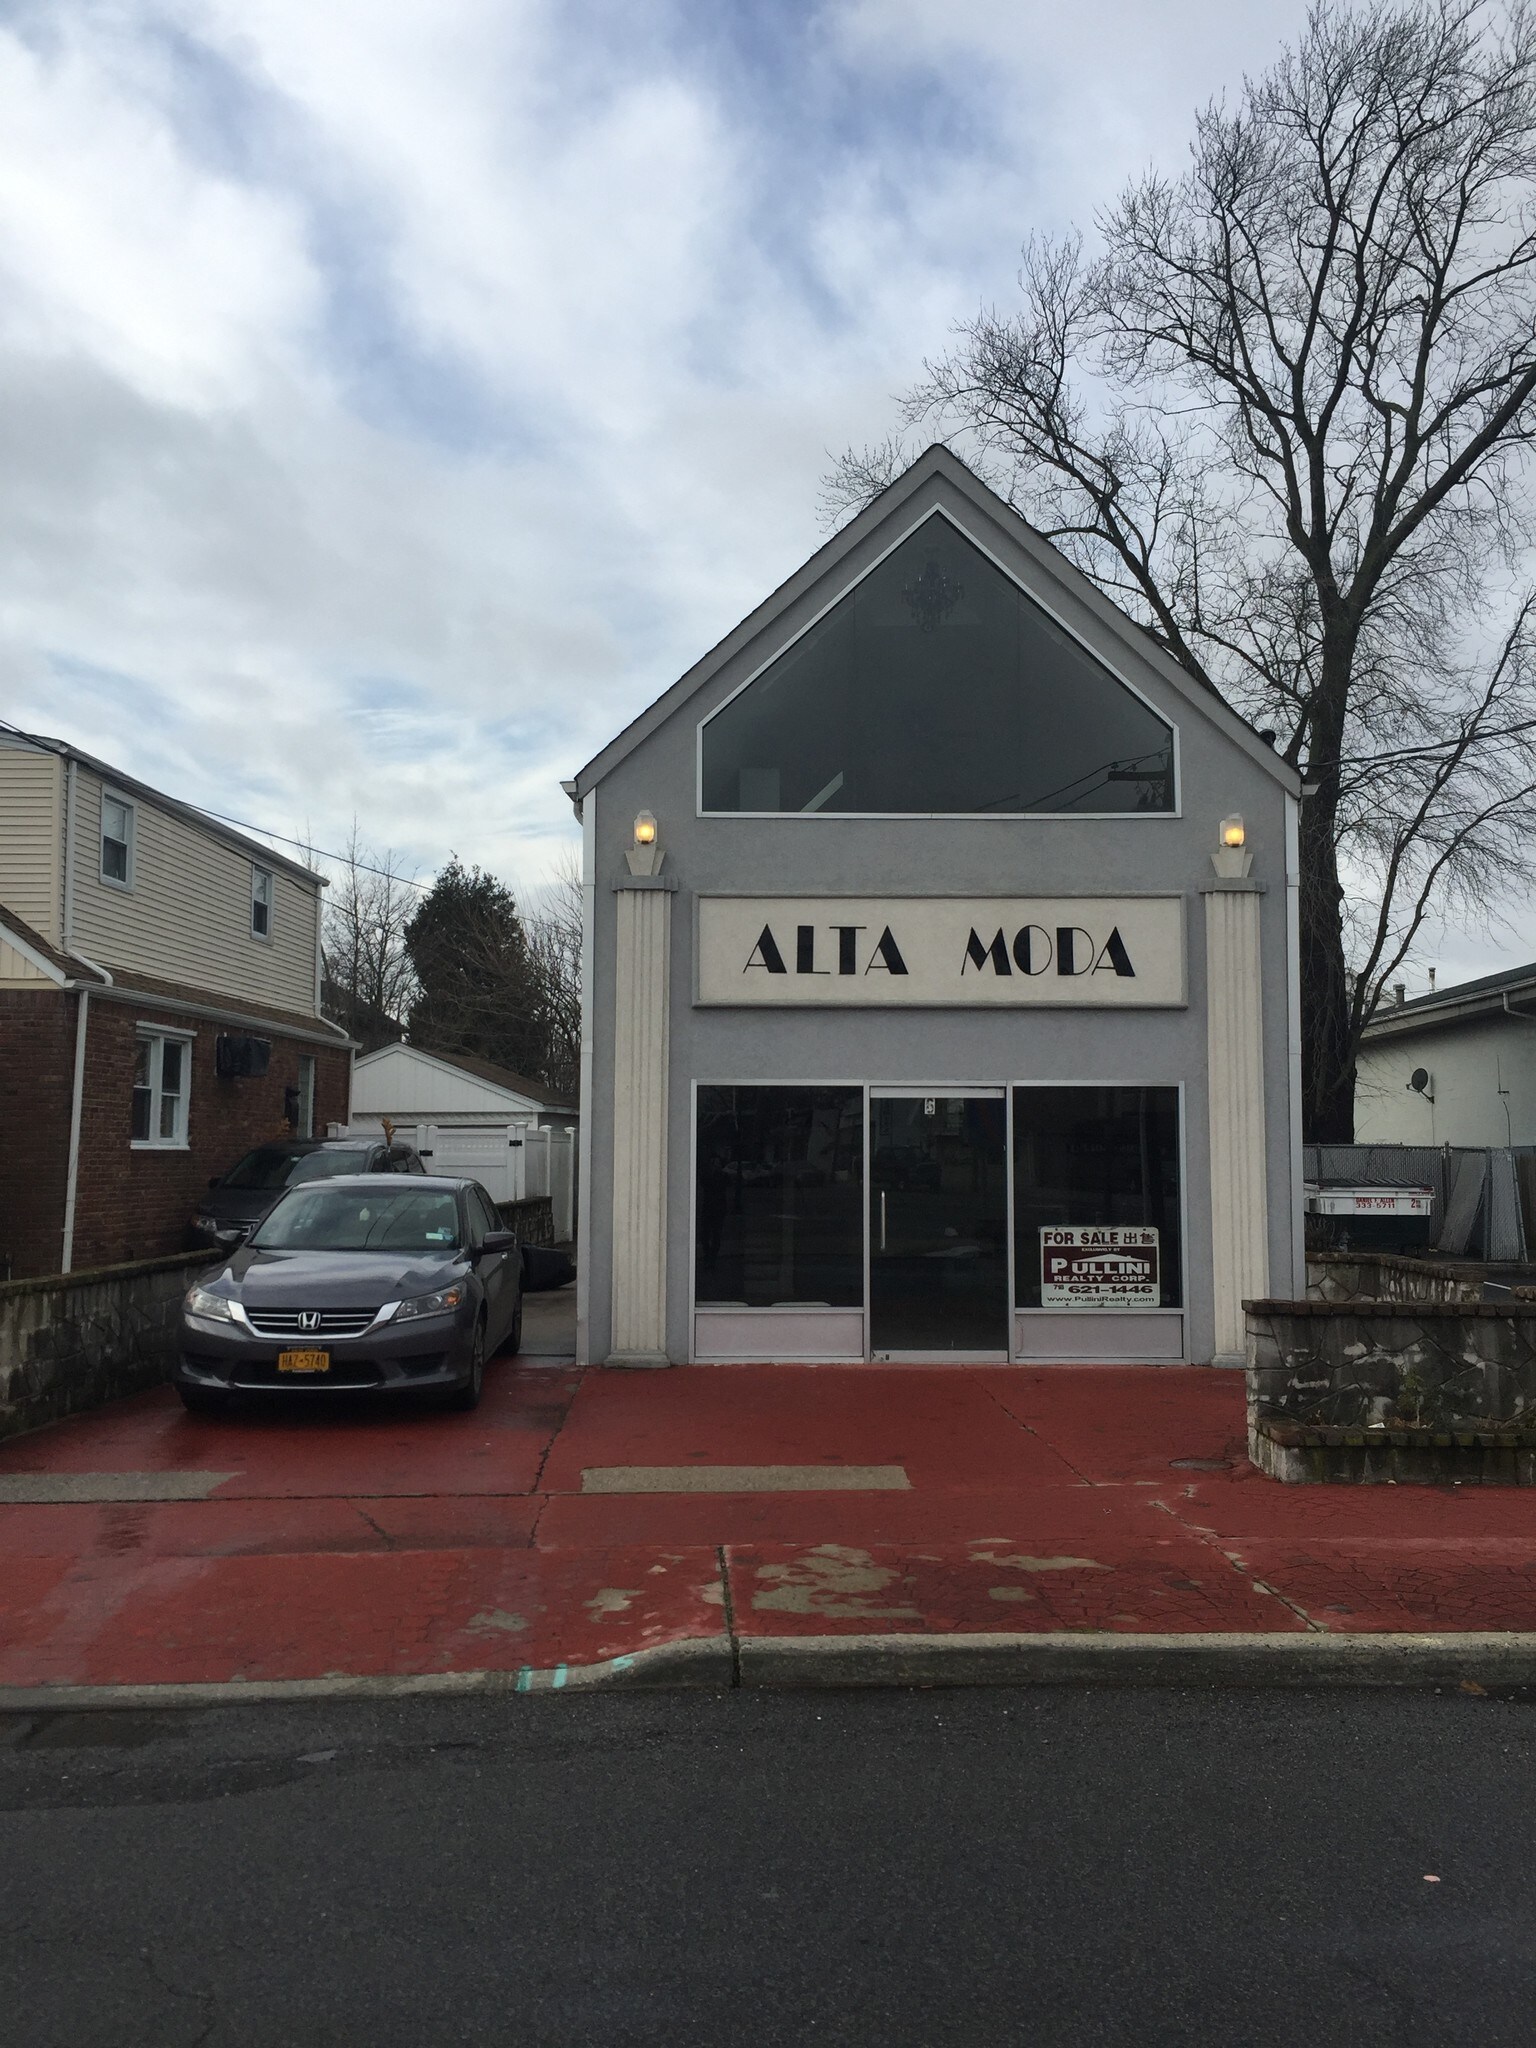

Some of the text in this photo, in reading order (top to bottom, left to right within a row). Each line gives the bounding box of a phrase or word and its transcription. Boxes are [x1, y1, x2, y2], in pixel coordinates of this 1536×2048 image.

[743, 923, 1136, 977] ALTA MODA
[1044, 1232, 1119, 1245] FOR SALE
[1124, 1232, 1155, 1244] 出售
[1068, 1285, 1153, 1294] 621-1446
